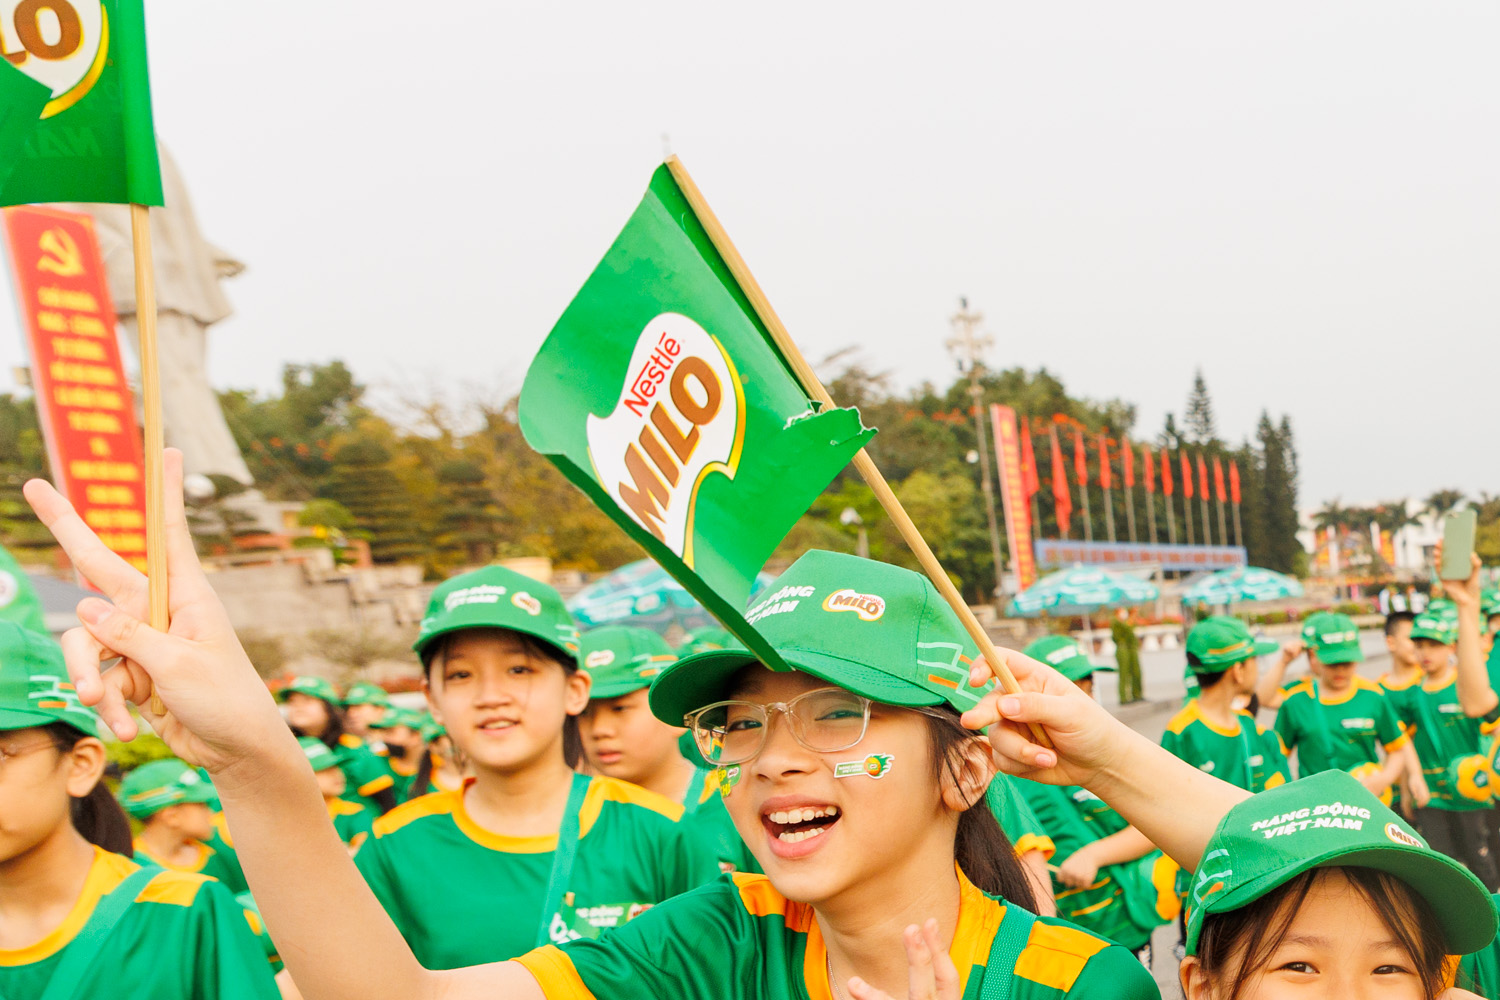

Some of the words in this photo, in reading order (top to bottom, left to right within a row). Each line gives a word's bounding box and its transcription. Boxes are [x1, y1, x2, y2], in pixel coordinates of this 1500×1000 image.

[624, 332, 681, 417] Nestlé
[618, 355, 724, 545] MILO
[833, 594, 880, 616] MILO
[1311, 802, 1371, 820] ĐỘNG
[1262, 819, 1312, 839] VIỆT
[1311, 817, 1363, 831] NAM
